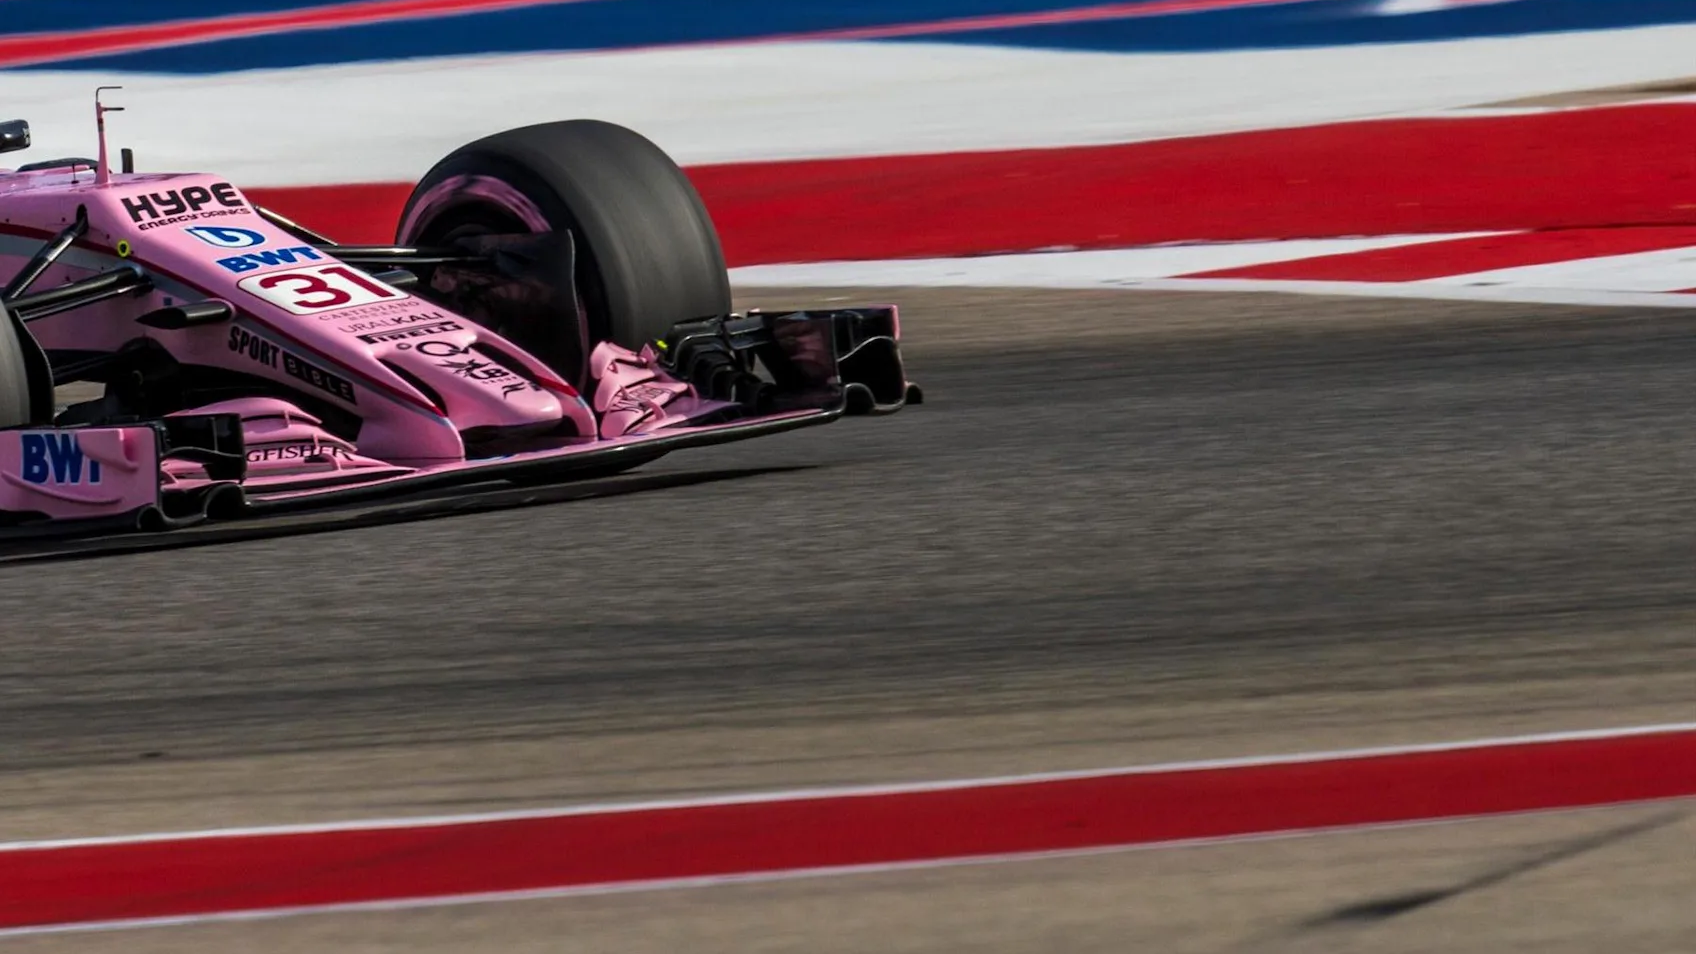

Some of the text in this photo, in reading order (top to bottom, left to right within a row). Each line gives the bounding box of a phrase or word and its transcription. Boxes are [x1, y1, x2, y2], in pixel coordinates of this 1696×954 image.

[121, 182, 244, 223] HYPE
[138, 207, 252, 231] ENERGY DRINKS
[215, 244, 325, 274] BWT
[259, 265, 397, 309] 31
[338, 311, 445, 334] URALKALI
[355, 320, 465, 345] PIRELLI
[228, 325, 351, 400] SPORT BIBLE
